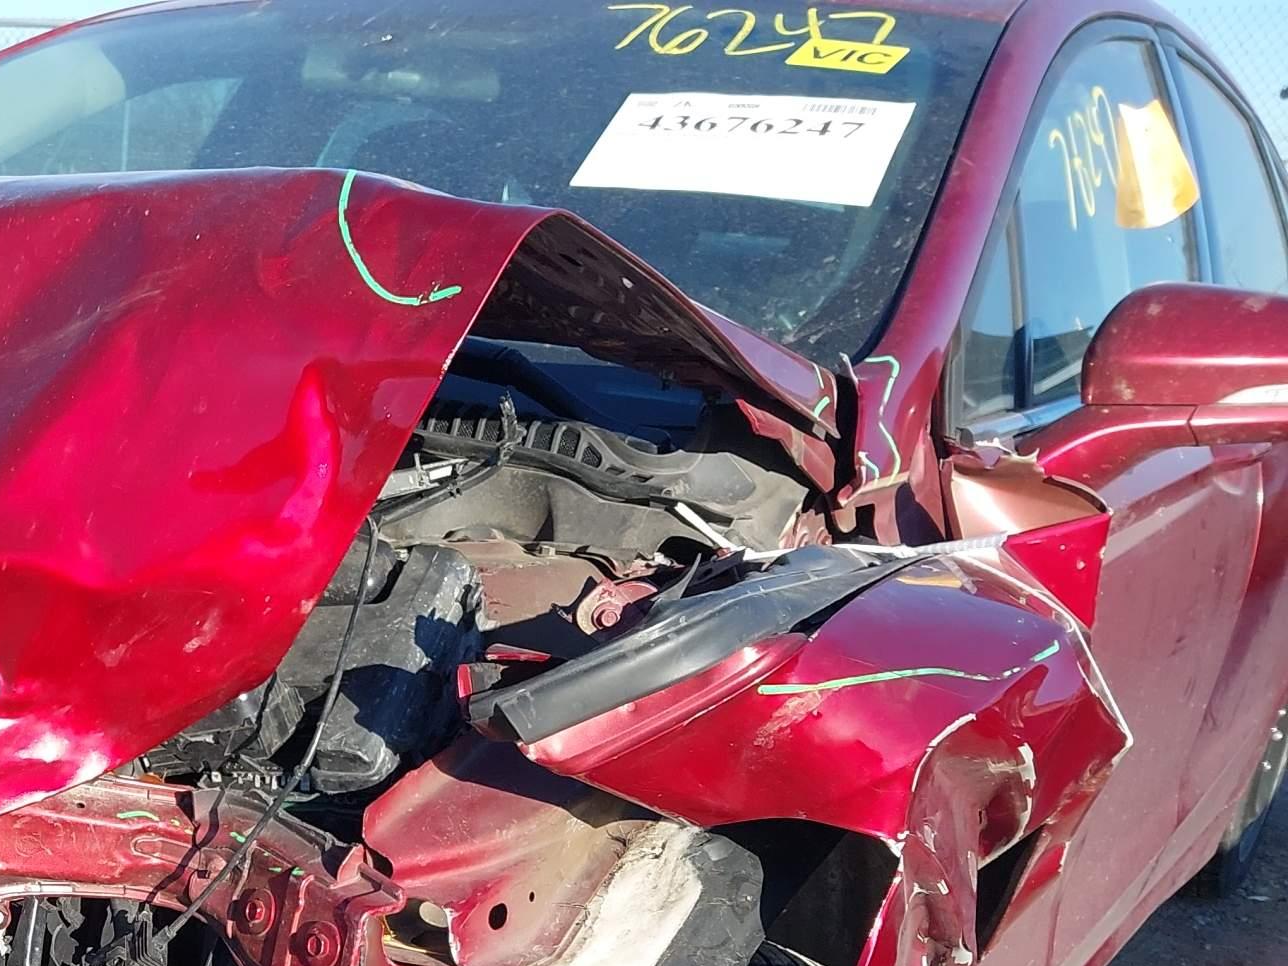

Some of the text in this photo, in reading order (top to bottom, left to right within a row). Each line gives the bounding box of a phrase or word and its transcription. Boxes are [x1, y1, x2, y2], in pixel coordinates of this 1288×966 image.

[608, 4, 894, 55] 76247
[813, 46, 893, 65] VIC
[638, 115, 865, 138] 43676247
